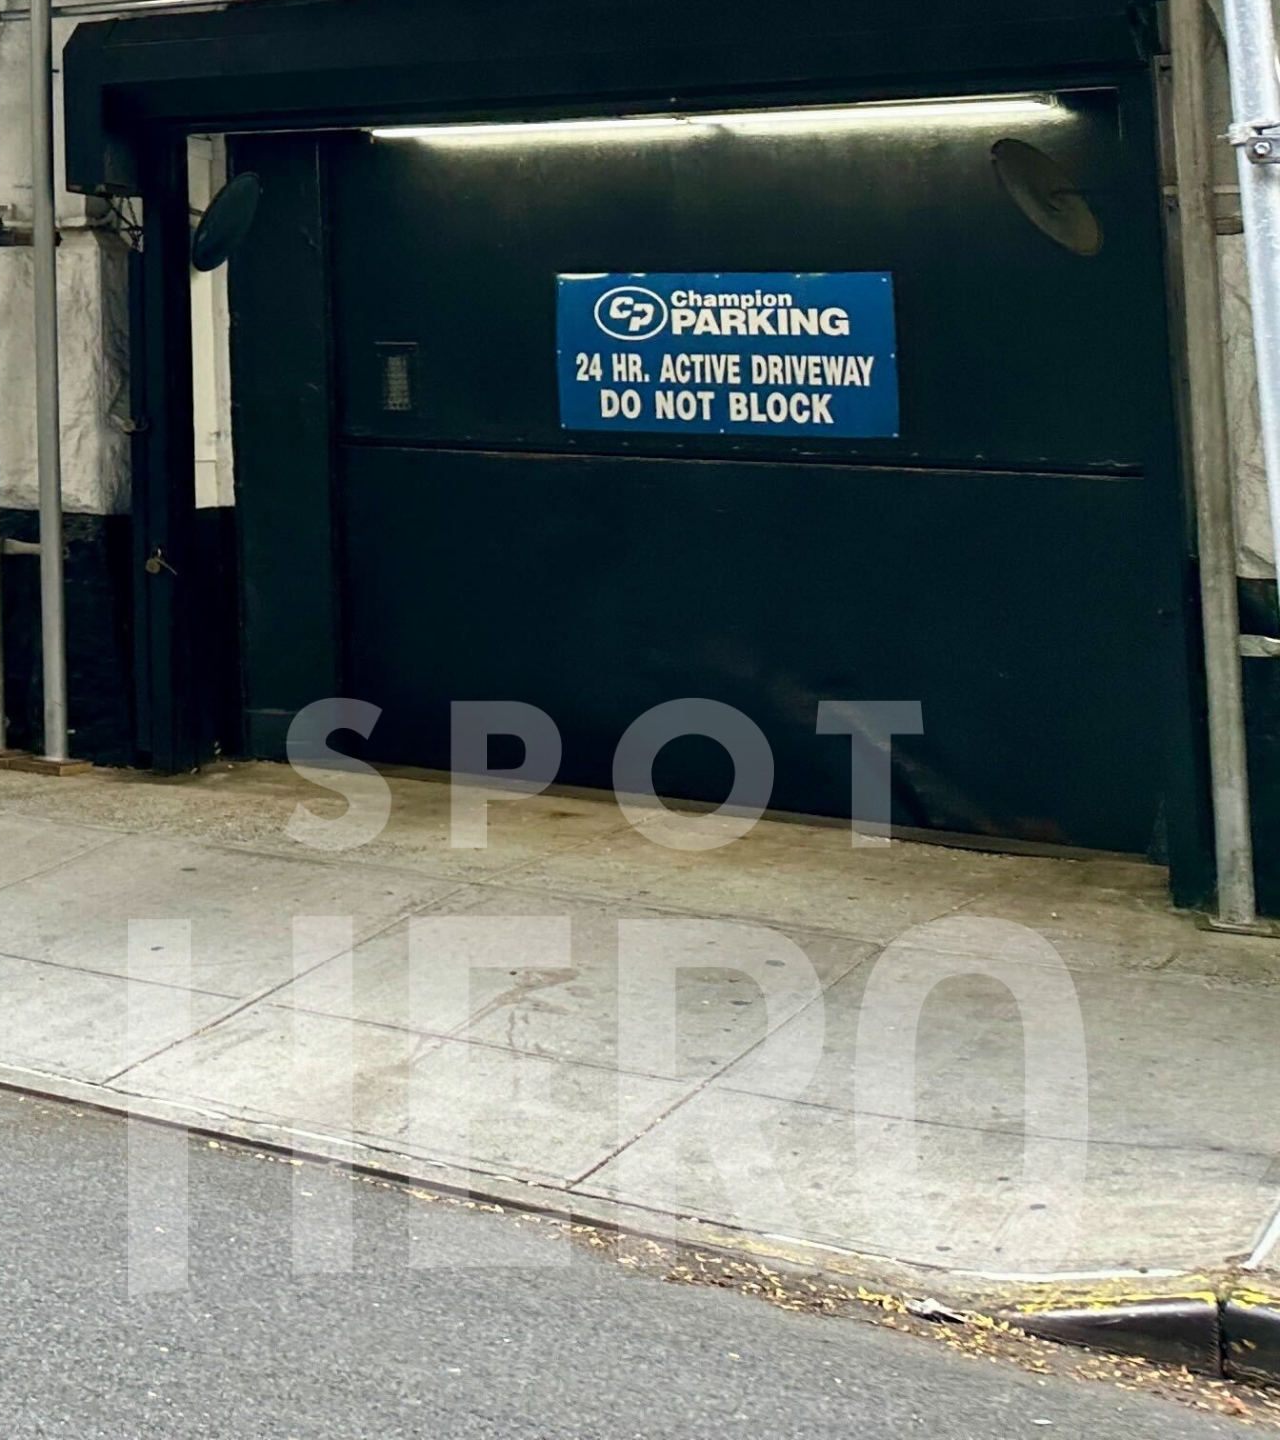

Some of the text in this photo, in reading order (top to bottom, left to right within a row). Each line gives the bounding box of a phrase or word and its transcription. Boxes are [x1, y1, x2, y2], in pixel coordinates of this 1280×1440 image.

[671, 290, 793, 308] Champion
[671, 308, 850, 336] PARKING
[575, 352, 875, 387] 24 HR. ACTIVE DRIVEWAY
[600, 389, 834, 424] DO NOT BLOCK
